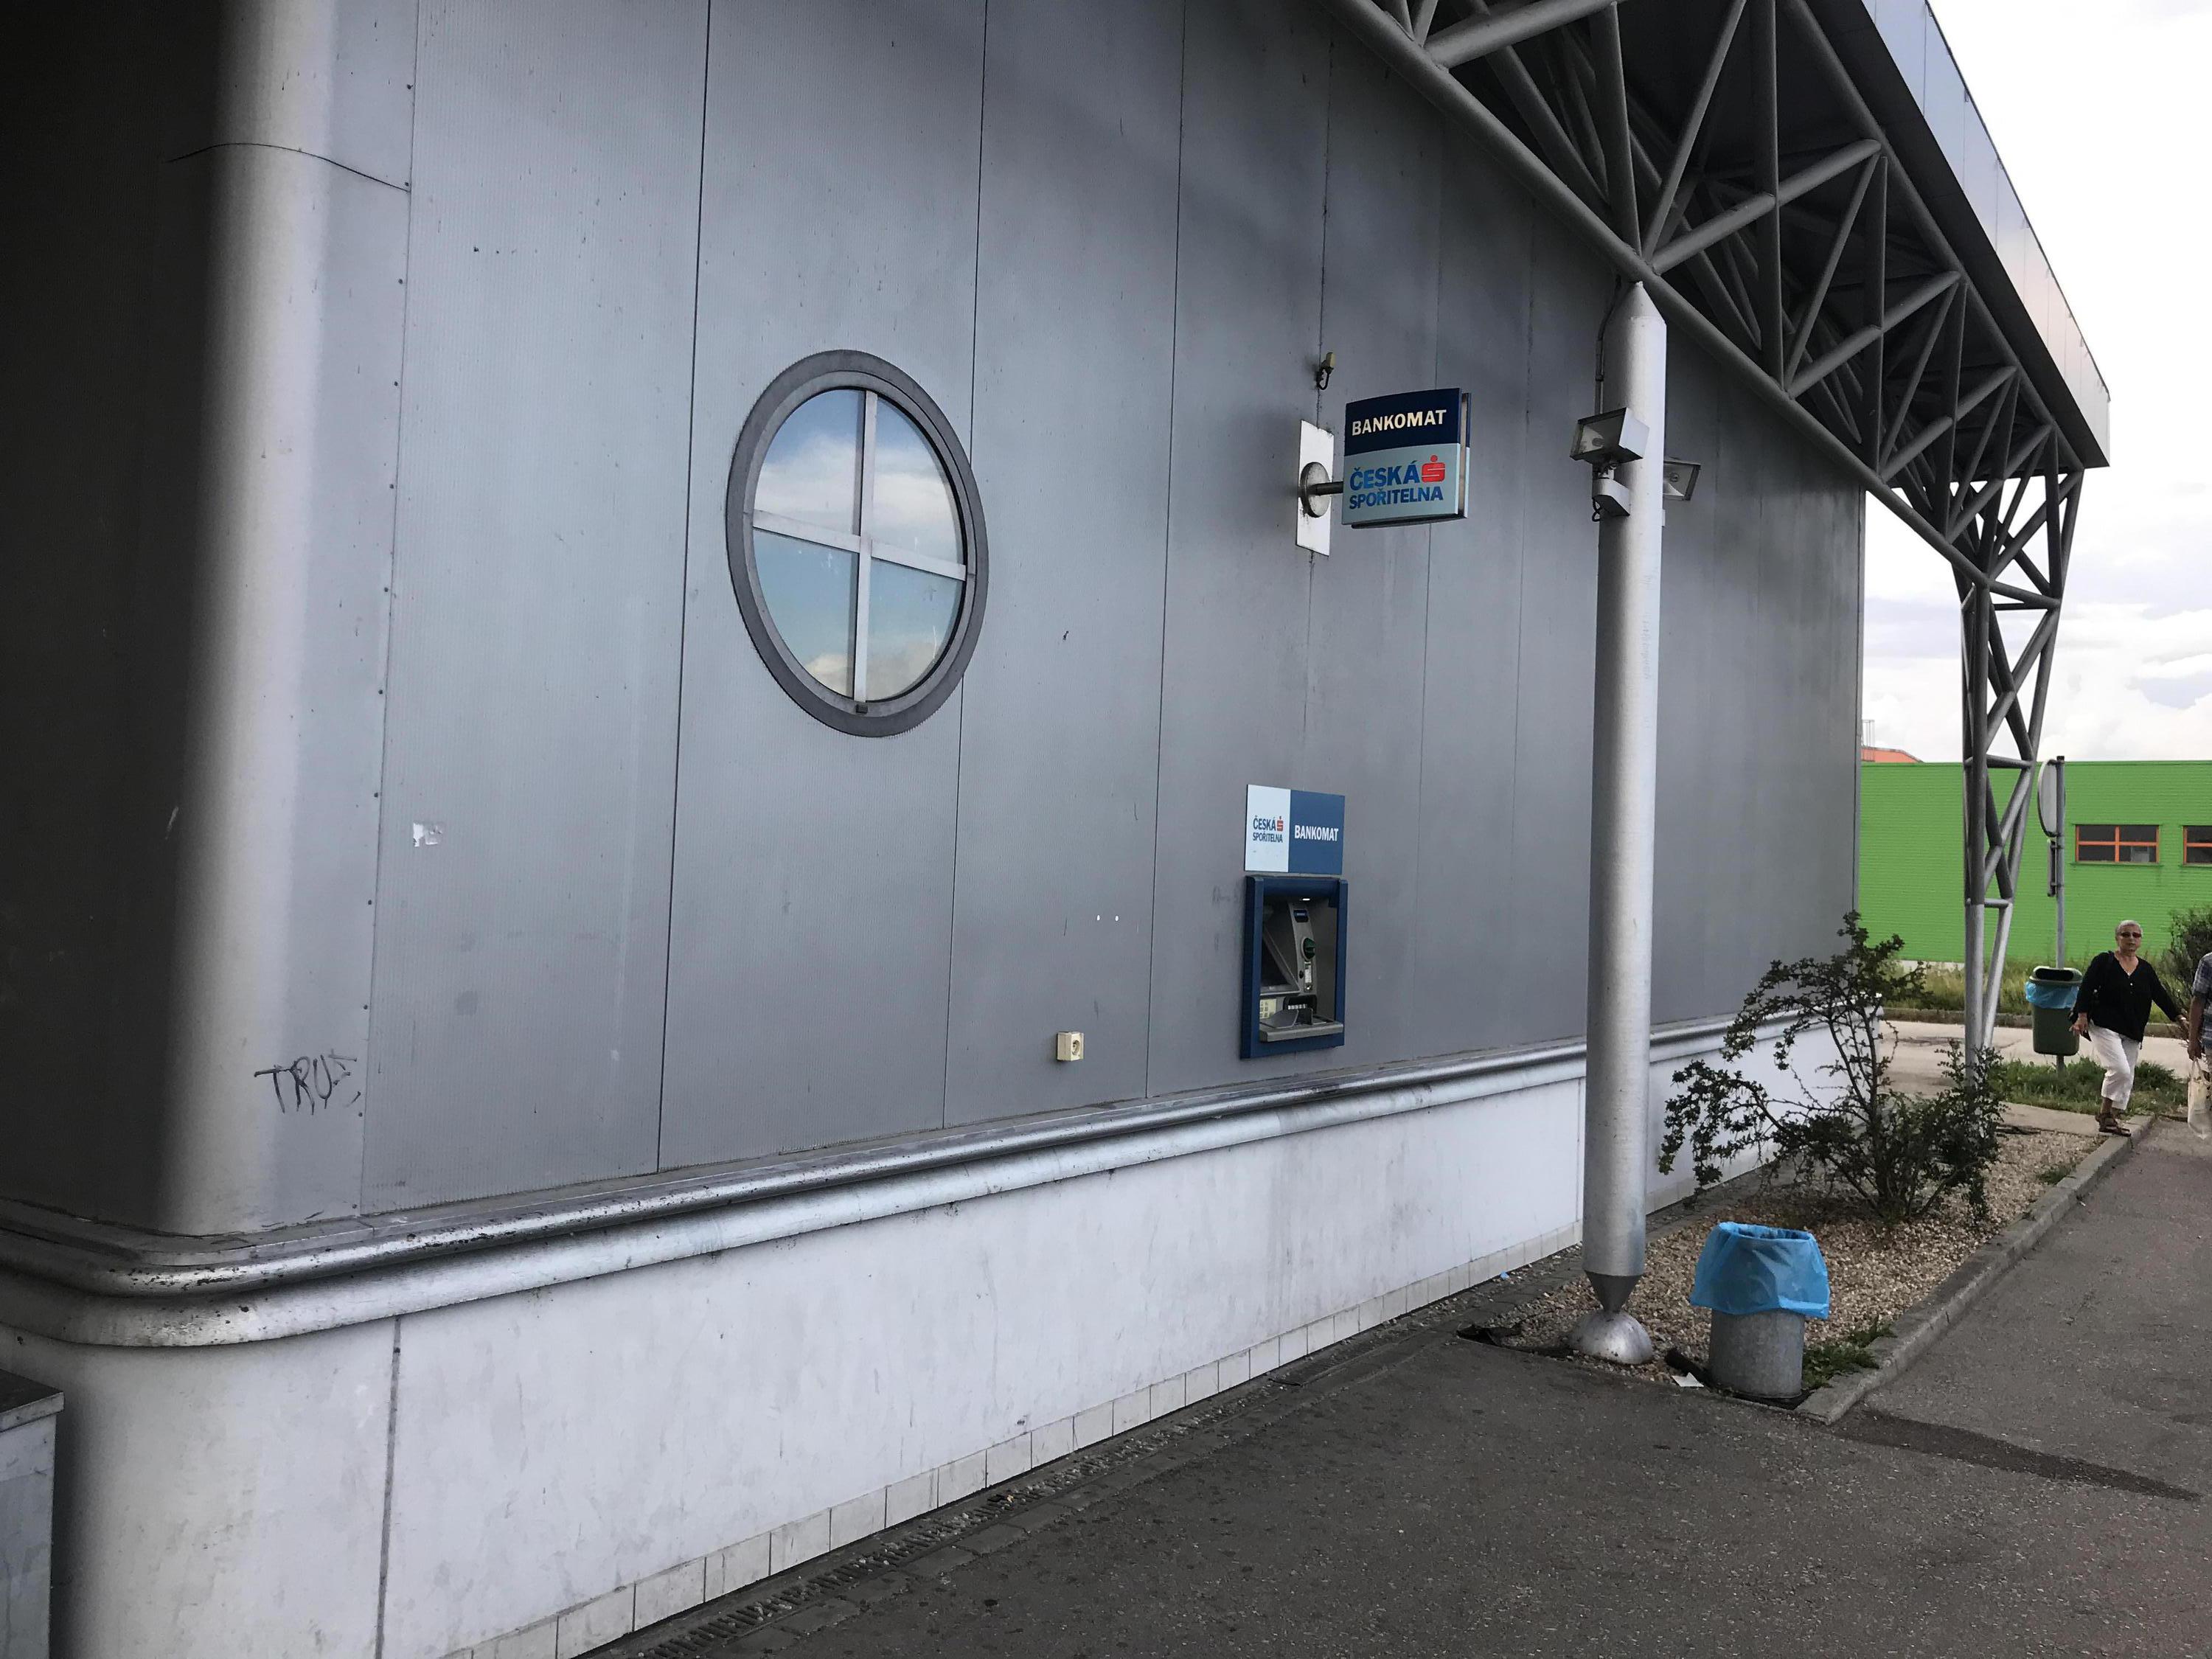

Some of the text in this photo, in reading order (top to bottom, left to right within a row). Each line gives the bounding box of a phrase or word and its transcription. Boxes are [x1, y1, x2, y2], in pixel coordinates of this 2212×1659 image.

[1352, 409, 1447, 436] BANKOMAT
[1349, 460, 1422, 491] ČESKÁ
[1349, 486, 1444, 509] SPOŘITELNA
[1253, 815, 1276, 832] ČESKÁ
[1294, 824, 1339, 842] BANKOMAT
[1252, 831, 1283, 844] SPOŘITELNA
